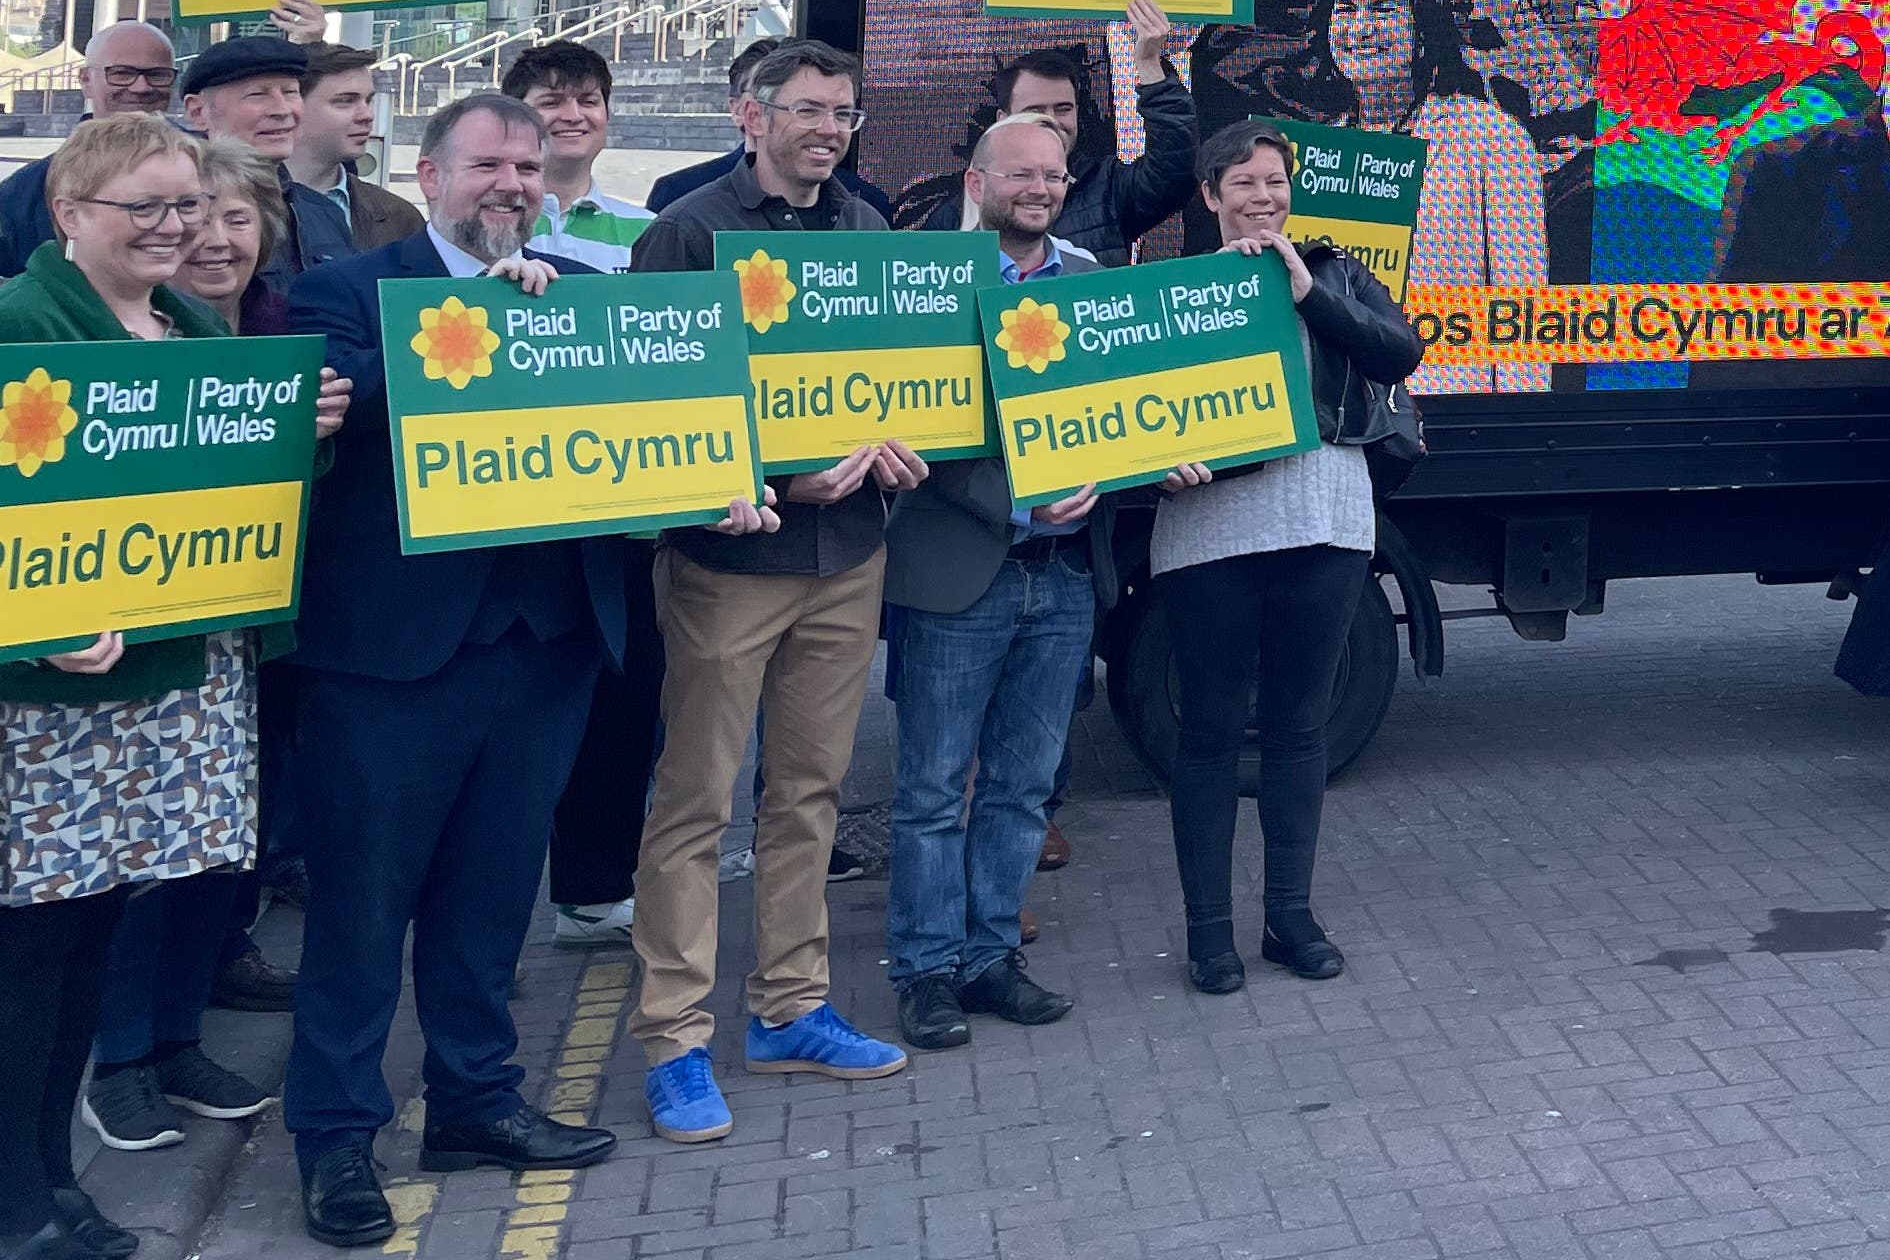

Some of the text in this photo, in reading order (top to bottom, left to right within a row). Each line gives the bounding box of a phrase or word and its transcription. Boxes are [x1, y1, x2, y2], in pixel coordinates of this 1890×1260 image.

[1304, 146, 1342, 169] Plaid
[1361, 153, 1415, 181] Party of
[1301, 169, 1349, 195] Cymru
[1358, 175, 1400, 199] Wales
[801, 261, 857, 287] Plaid
[892, 260, 974, 290] Party of
[802, 291, 879, 324] Cymru
[892, 289, 959, 315] Wales
[1072, 293, 1135, 325] Plaid
[1170, 274, 1260, 310] Party of
[505, 307, 576, 337] Plaid
[619, 302, 722, 337] Party of
[1174, 306, 1249, 336] Wales
[1488, 296, 1616, 346] Blaid
[1630, 297, 1804, 355] Cymru
[1820, 306, 1868, 342] ar
[620, 336, 706, 364] Wales
[1078, 320, 1161, 355] Cymru
[508, 340, 604, 377] Cymru
[87, 380, 158, 415] Plaid
[199, 373, 302, 413] Party of
[757, 372, 972, 422] laid Cymru
[196, 412, 276, 446] Wales
[1013, 402, 1126, 457] Plaid
[1135, 382, 1276, 437] Cymru
[82, 419, 178, 461] Cymru
[415, 429, 735, 488] Plaid Cymru
[0, 522, 282, 590] laid Cymru
